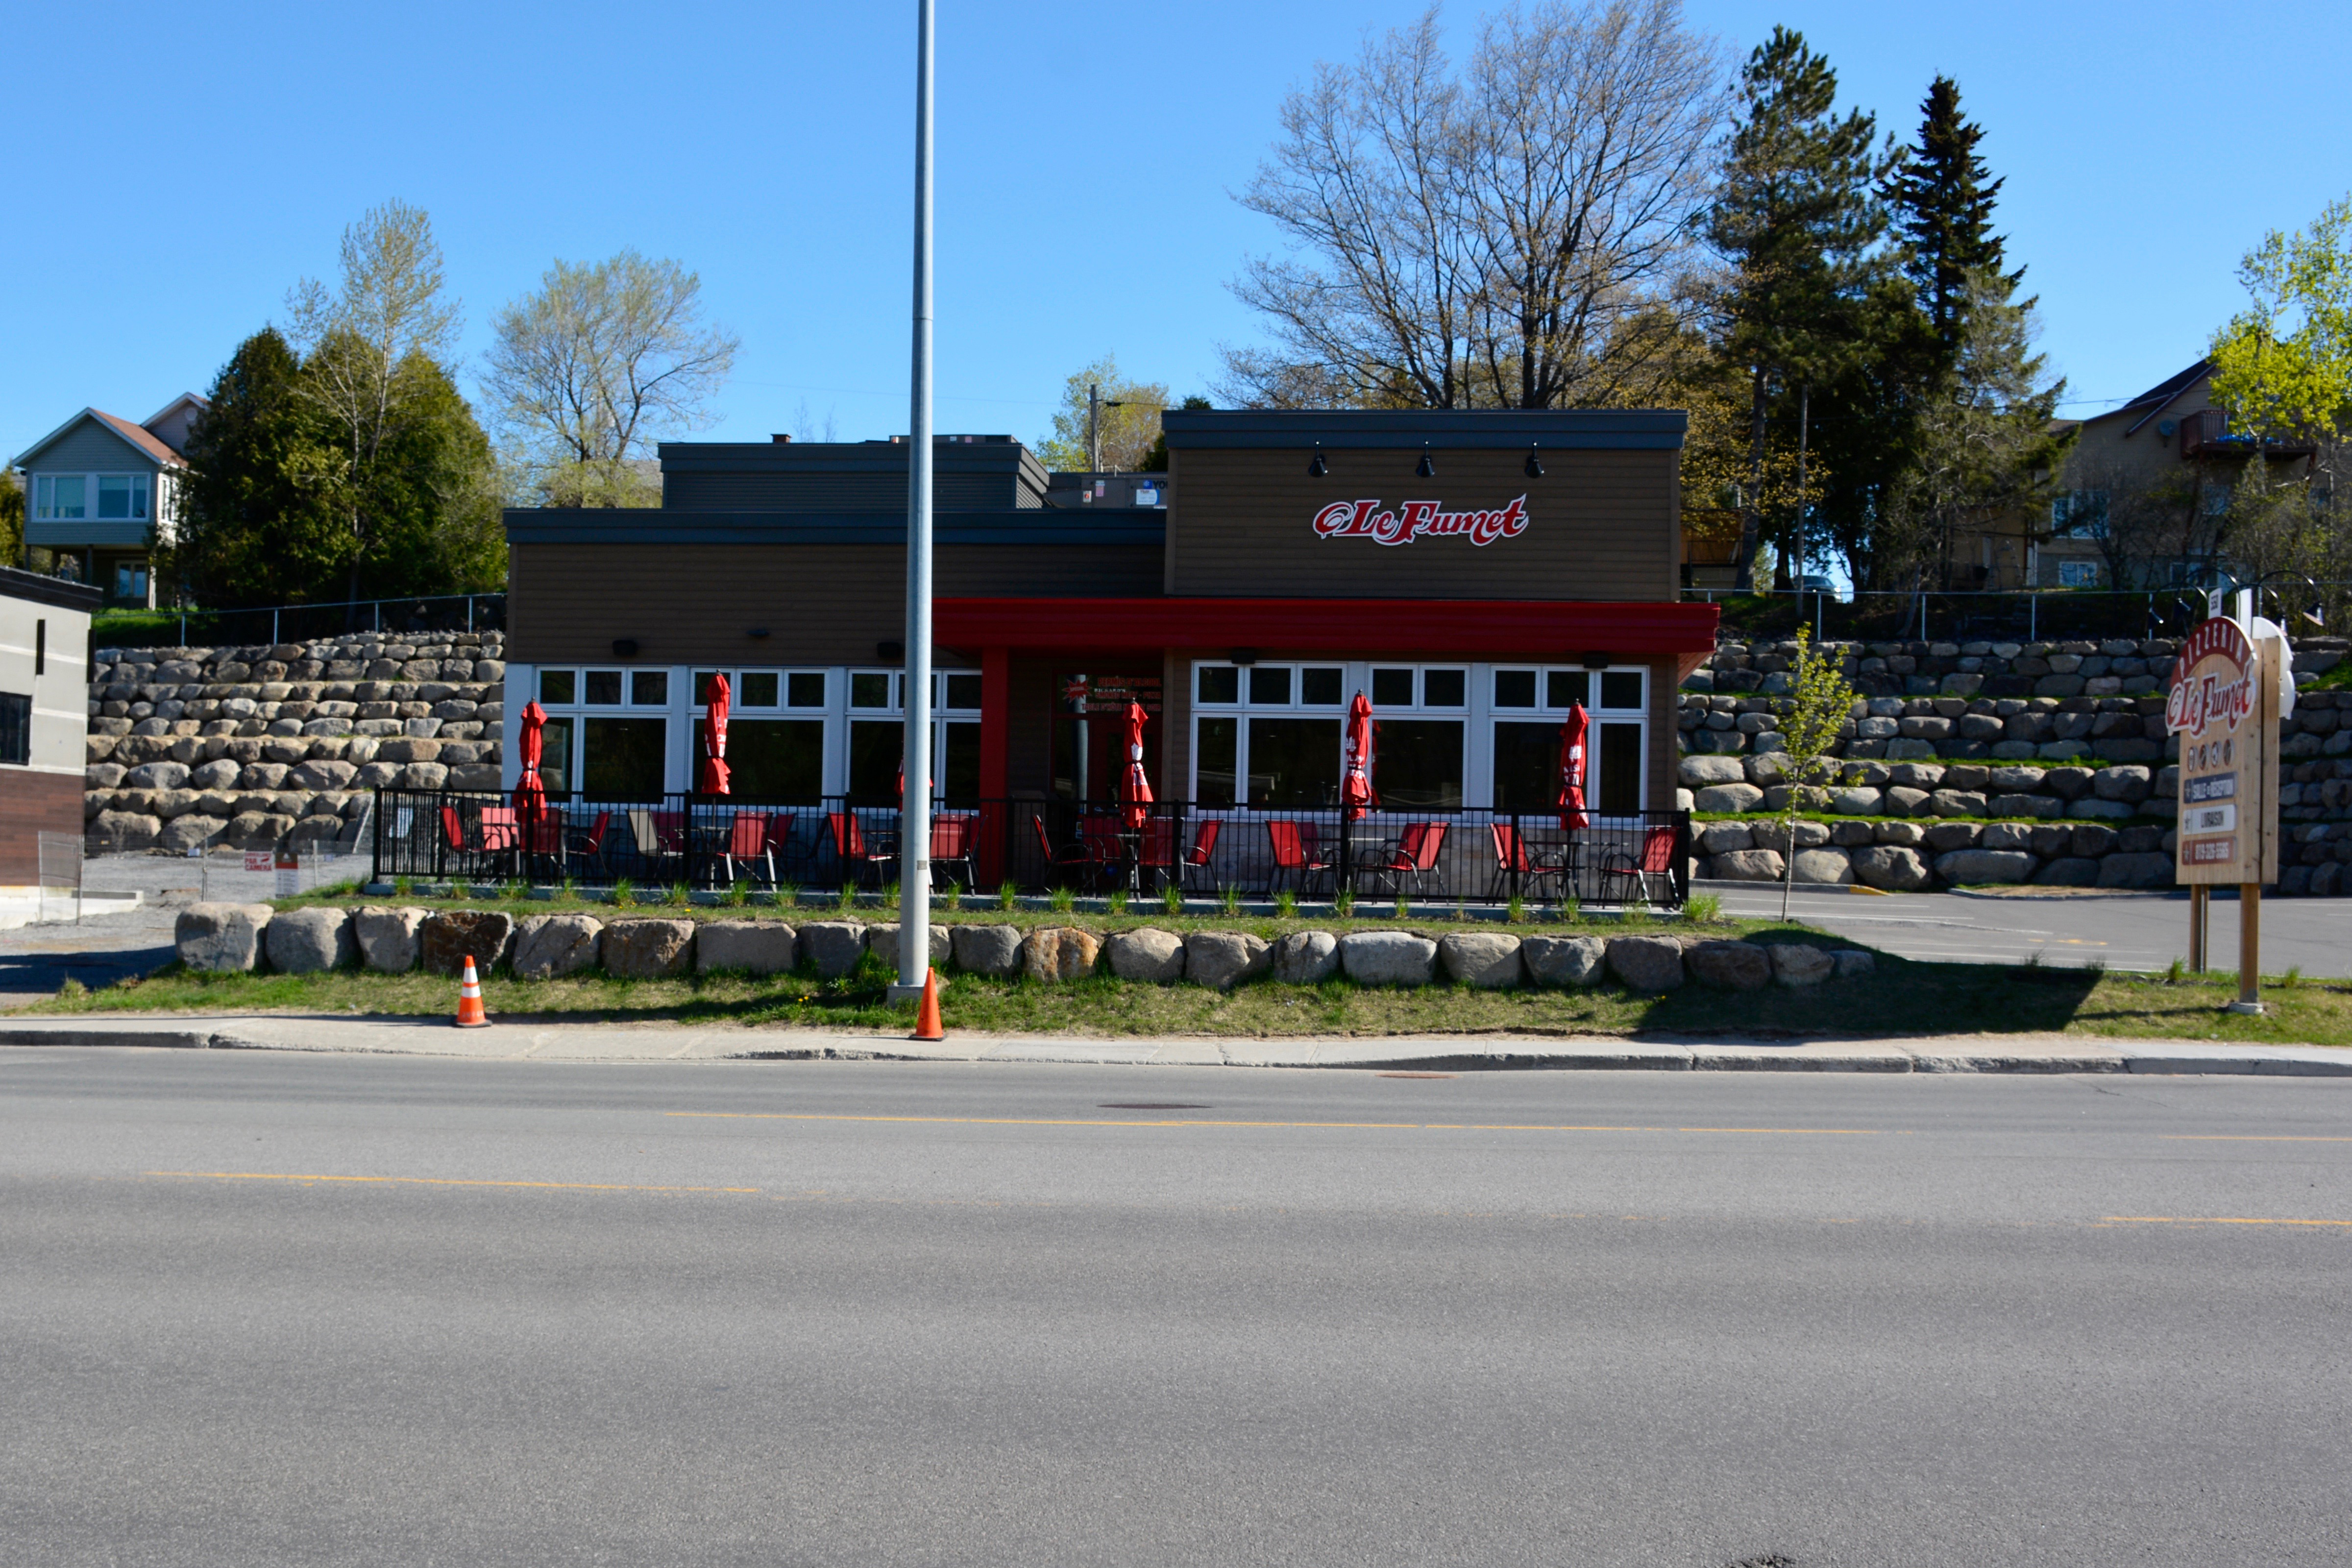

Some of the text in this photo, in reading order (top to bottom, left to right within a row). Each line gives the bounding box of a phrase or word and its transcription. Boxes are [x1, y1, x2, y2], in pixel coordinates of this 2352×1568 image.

[1153, 481, 1168, 489] YO
[1313, 493, 1529, 546] Le Fumet
[2180, 623, 2243, 678] PIZZERIA
[1098, 677, 1126, 687] PERMIS
[2166, 657, 2256, 739] Le Fumet
